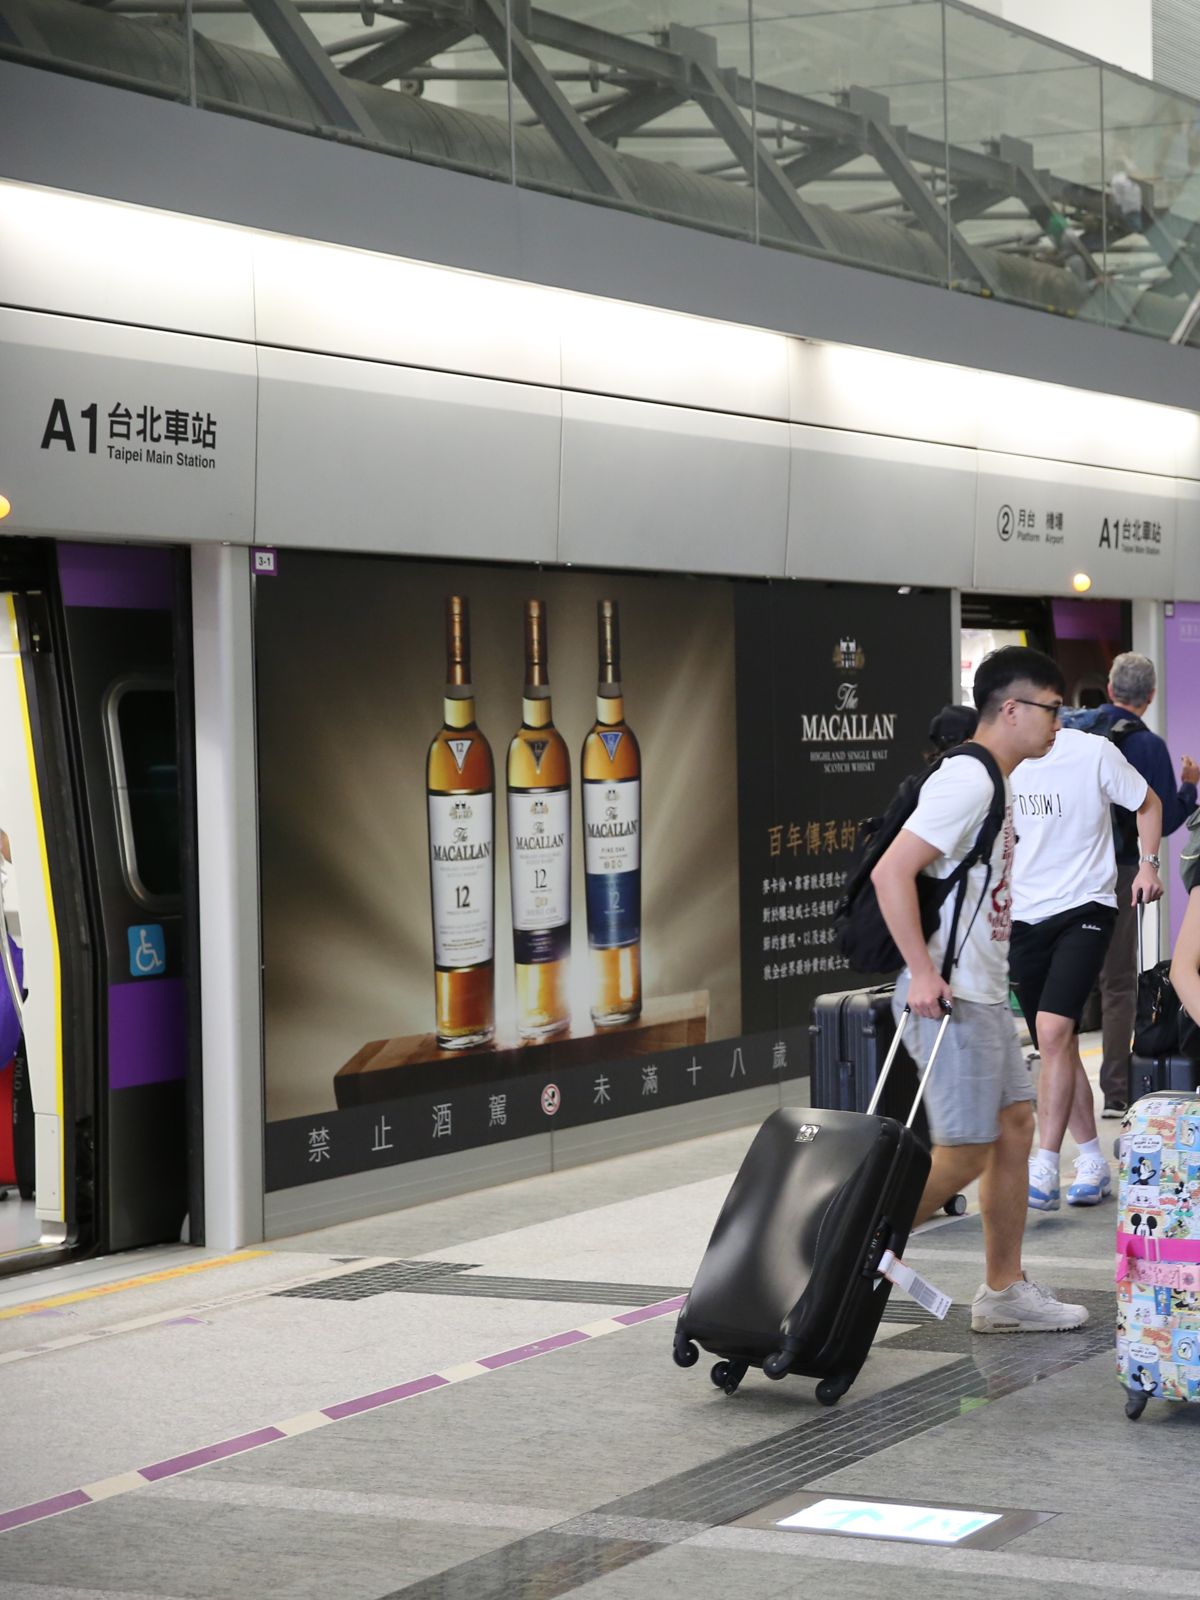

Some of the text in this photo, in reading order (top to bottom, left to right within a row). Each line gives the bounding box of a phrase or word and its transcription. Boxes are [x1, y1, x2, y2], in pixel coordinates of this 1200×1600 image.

[40, 398, 217, 454] A1 台北車站
[107, 445, 216, 469] Taipei Main Station
[1018, 509, 1035, 528] 月台
[1017, 530, 1064, 545] Platform Airport
[1098, 517, 1161, 549] A1 台北車站
[258, 556, 271, 567] 3-1
[835, 683, 858, 711] The
[801, 714, 897, 741] MACALLAN
[810, 749, 888, 762] HIGHLAND SINGLE MALT
[824, 762, 876, 773] SCOTCH WHISKY
[587, 819, 639, 839] MACALLAN
[768, 820, 863, 857] 百年傳承的
[433, 841, 491, 861] MACALLAN
[516, 833, 564, 850] MACALLAN
[534, 868, 547, 889] 12
[456, 885, 470, 909] 12
[308, 1040, 789, 1162] 禁止酒駕 未滿十八歲
